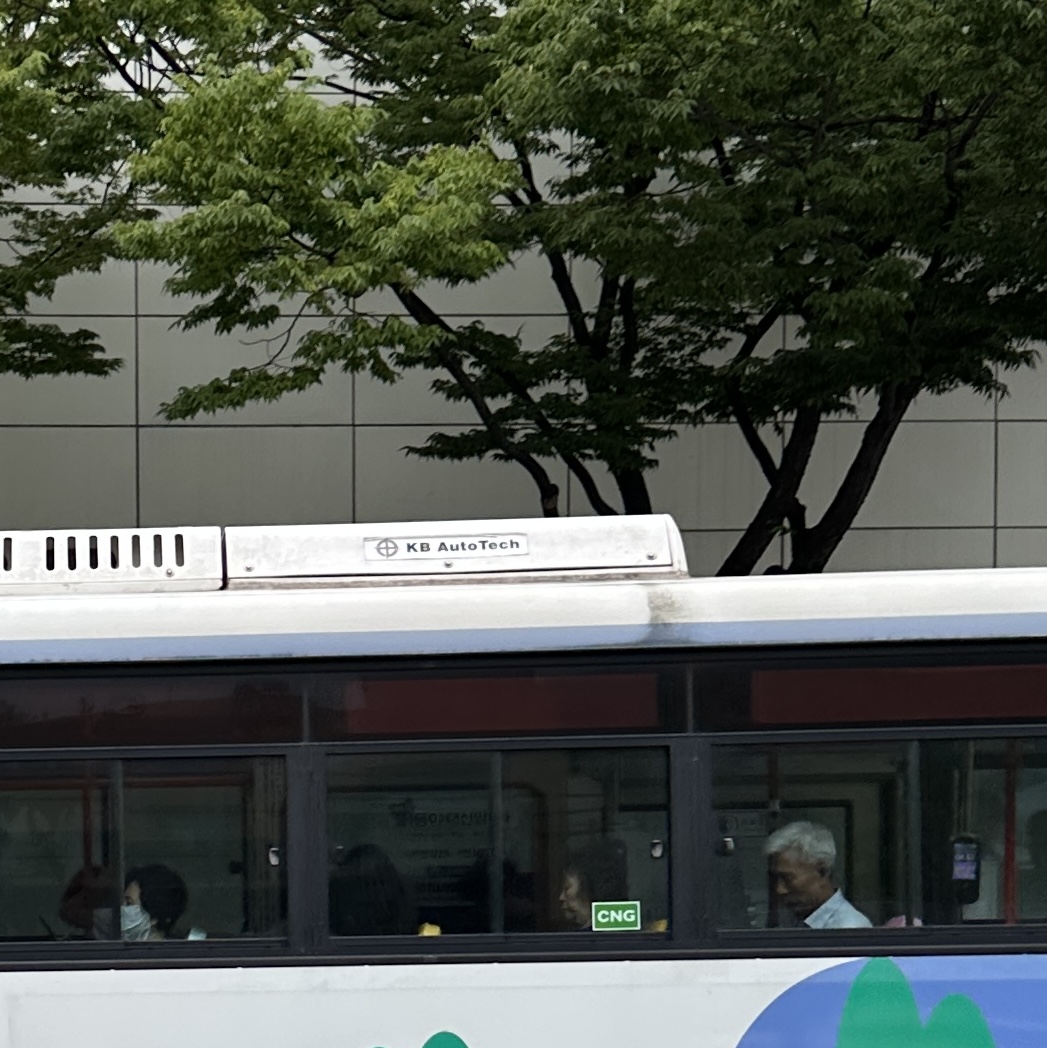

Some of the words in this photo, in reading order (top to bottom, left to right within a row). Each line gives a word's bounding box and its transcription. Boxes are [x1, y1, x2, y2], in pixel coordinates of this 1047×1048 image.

[406, 542, 431, 553] KB
[437, 539, 520, 552] AutoTech
[596, 909, 636, 922] CNG
